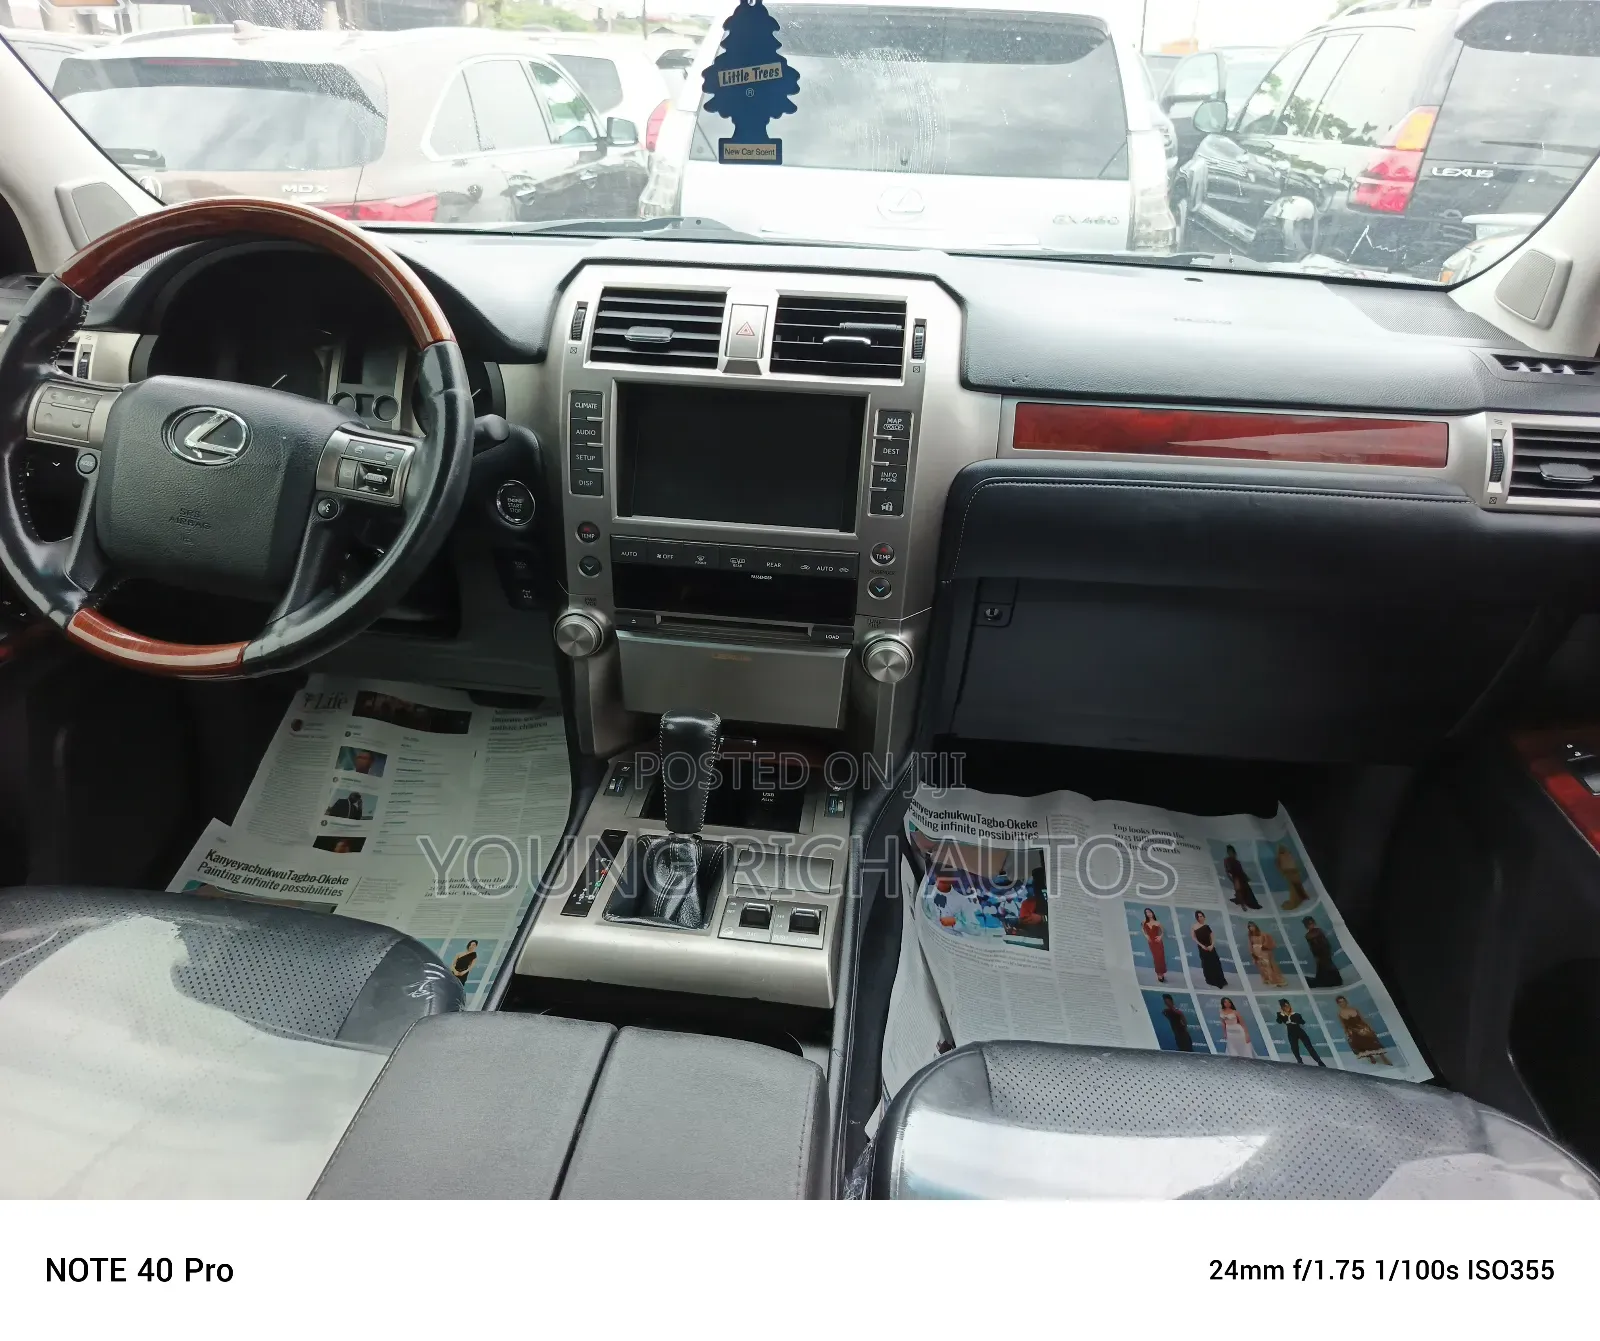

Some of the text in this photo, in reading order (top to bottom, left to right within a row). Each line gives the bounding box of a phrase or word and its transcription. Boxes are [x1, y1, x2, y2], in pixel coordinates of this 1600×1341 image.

[722, 67, 780, 85] Little Trees
[724, 147, 775, 156] New Car Scent
[1432, 167, 1494, 178] LEXUS
[282, 184, 328, 193] MDX
[575, 402, 598, 410] CLIMATE
[911, 798, 1038, 830] anyeyachukwuTagbo-Okeke
[940, 821, 977, 835] infinite
[978, 828, 1039, 842] possibilities
[1113, 823, 1128, 832] Top
[1129, 826, 1150, 834] looks
[1151, 828, 1172, 837] from
[205, 849, 349, 885] KanyeyachukwuTagbo-Okeke
[198, 861, 343, 897] Painting infinite possibilities
